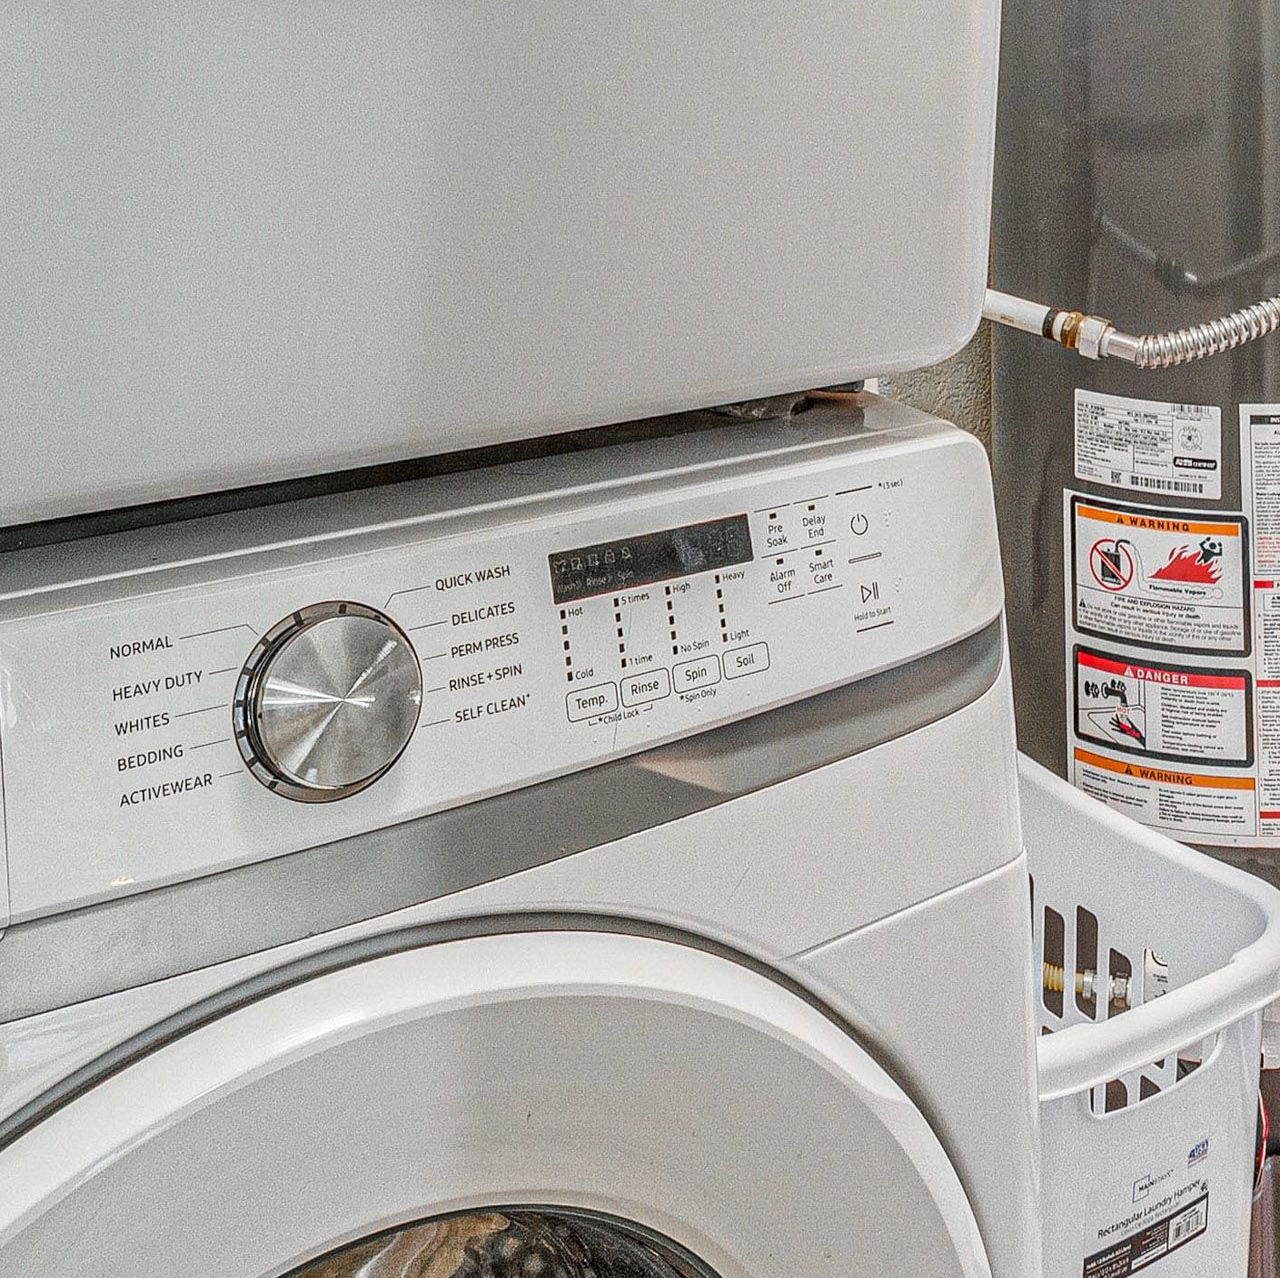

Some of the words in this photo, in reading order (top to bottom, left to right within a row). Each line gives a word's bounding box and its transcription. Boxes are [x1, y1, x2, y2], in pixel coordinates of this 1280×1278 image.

[802, 515, 826, 527] Delay
[1130, 516, 1189, 531] WARNING
[768, 524, 783, 534] Pre
[809, 528, 824, 539] End
[767, 535, 788, 548] Soak
[809, 559, 834, 573] Smart
[435, 572, 473, 591] QUICK
[475, 565, 511, 582] WASH
[722, 571, 745, 582] Heavy
[770, 568, 796, 582] Alarm
[814, 574, 833, 584] Care
[673, 582, 691, 595] High
[777, 581, 792, 593] Off
[1149, 584, 1182, 594] Flammable
[1184, 588, 1206, 596] Vapors
[621, 597, 627, 605] 5
[629, 591, 650, 604] times
[451, 602, 515, 626] DELICATES
[568, 607, 583, 617] Hot
[854, 611, 868, 621] Hold
[869, 610, 876, 618] to
[876, 606, 891, 617] Start
[730, 630, 750, 642] Light
[110, 636, 173, 659] NORMAL
[451, 641, 482, 658] PERM
[485, 633, 519, 650] PRESS
[681, 644, 691, 653] No
[692, 640, 710, 653] Spin
[629, 658, 633, 666] 1
[634, 655, 653, 665] time
[736, 654, 755, 667] Soil
[576, 669, 594, 680] Cold
[685, 667, 707, 682] Spin
[1137, 669, 1188, 685] DANGER
[113, 679, 161, 701] HEAVY
[165, 671, 203, 690] DUTY
[631, 679, 660, 696] Rinse
[701, 688, 717, 698] Only
[576, 696, 608, 712] Temp.
[455, 706, 483, 723] SELF
[623, 708, 640, 720] Lock
[114, 712, 170, 736] WHITES
[118, 745, 184, 771] BEDDING
[1140, 768, 1193, 785] WARNING
[120, 773, 213, 807] ACTIVEWEAR
[1097, 1211, 1143, 1239] Rectangular
[1143, 1195, 1173, 1217] Laundry
[1174, 1179, 1201, 1200] Hamper
